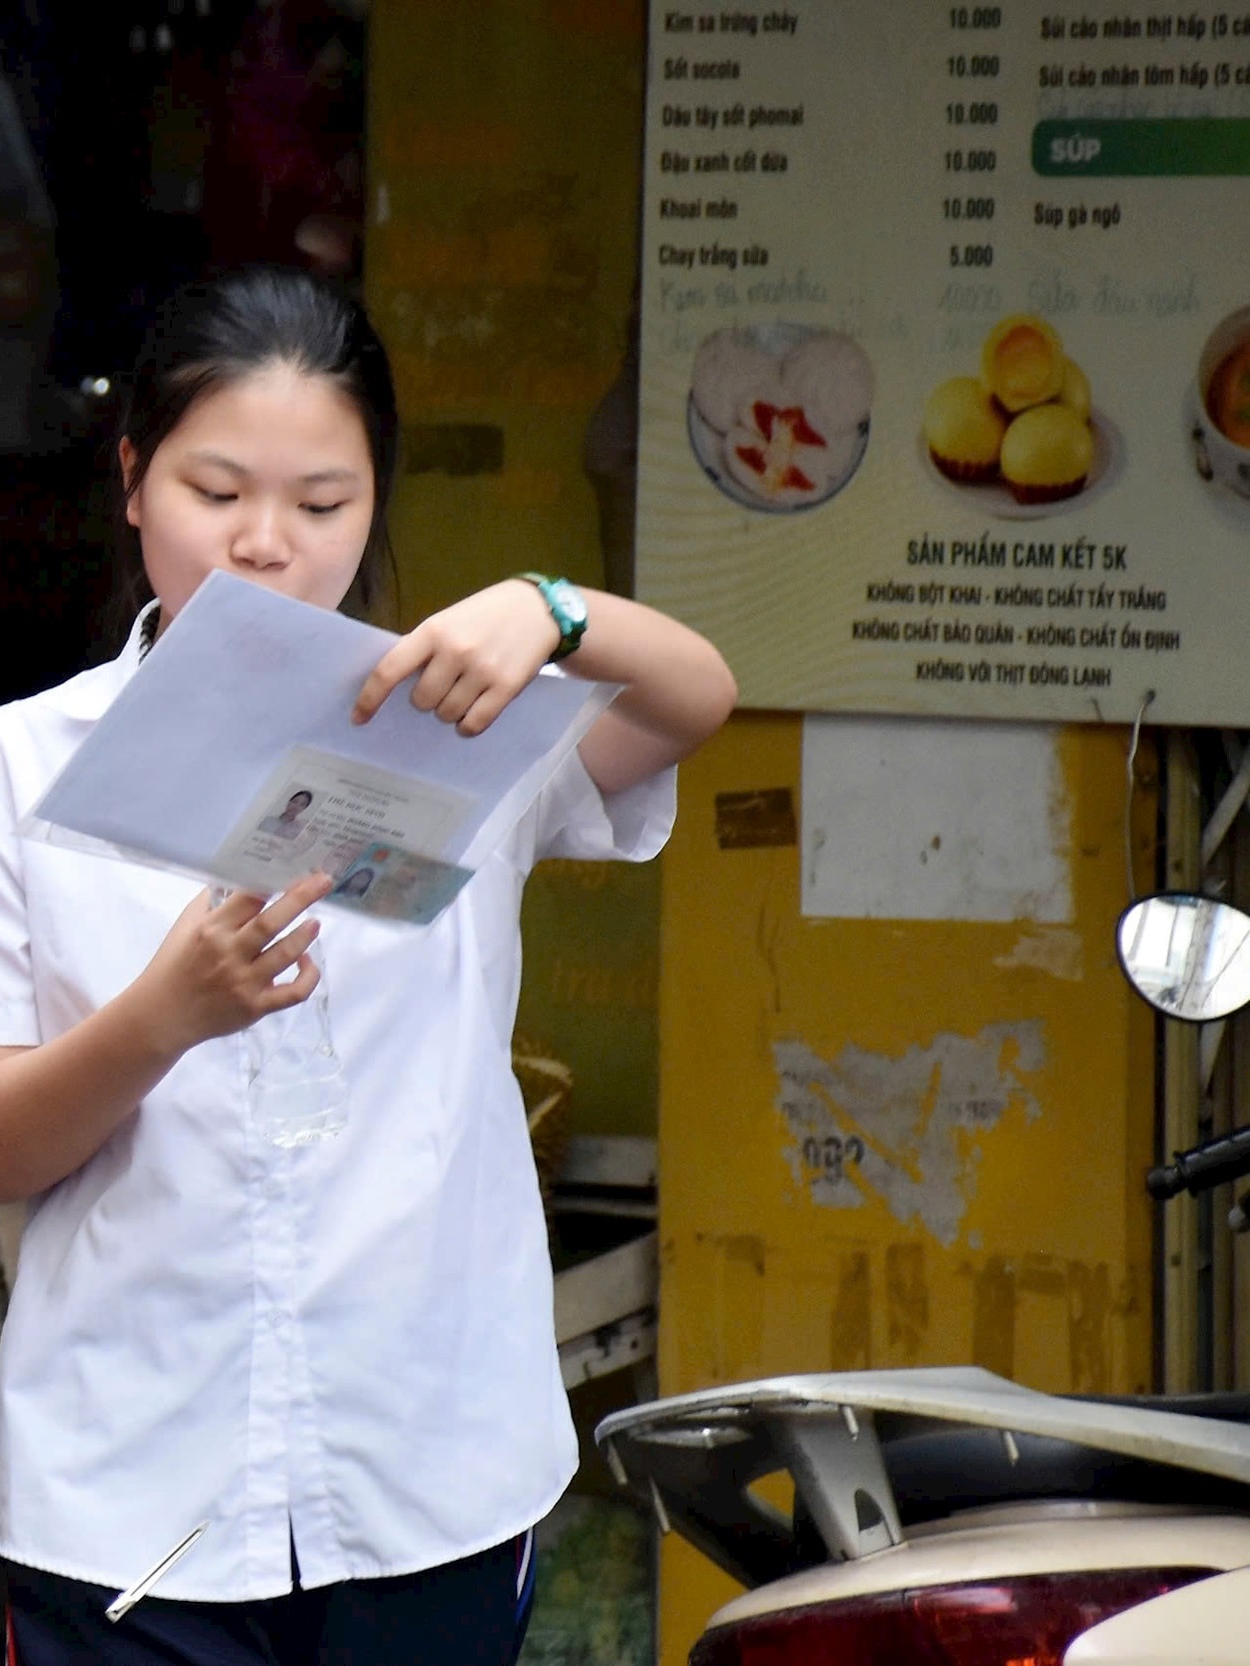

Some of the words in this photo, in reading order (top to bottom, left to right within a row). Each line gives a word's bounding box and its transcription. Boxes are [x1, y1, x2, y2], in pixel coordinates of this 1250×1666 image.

[950, 7, 1001, 29] 10.000
[947, 55, 1000, 78] 10.000
[946, 102, 998, 125] 10.000
[1050, 133, 1101, 163] SÚP
[945, 150, 996, 173] 10.000
[943, 197, 995, 220] 10.000
[950, 245, 994, 267] 5.000
[906, 532, 946, 566] SẢN
[1012, 542, 1055, 569] CAM
[1061, 535, 1096, 570] KẾT
[1102, 543, 1127, 571] 5K
[949, 585, 982, 605] KHAI
